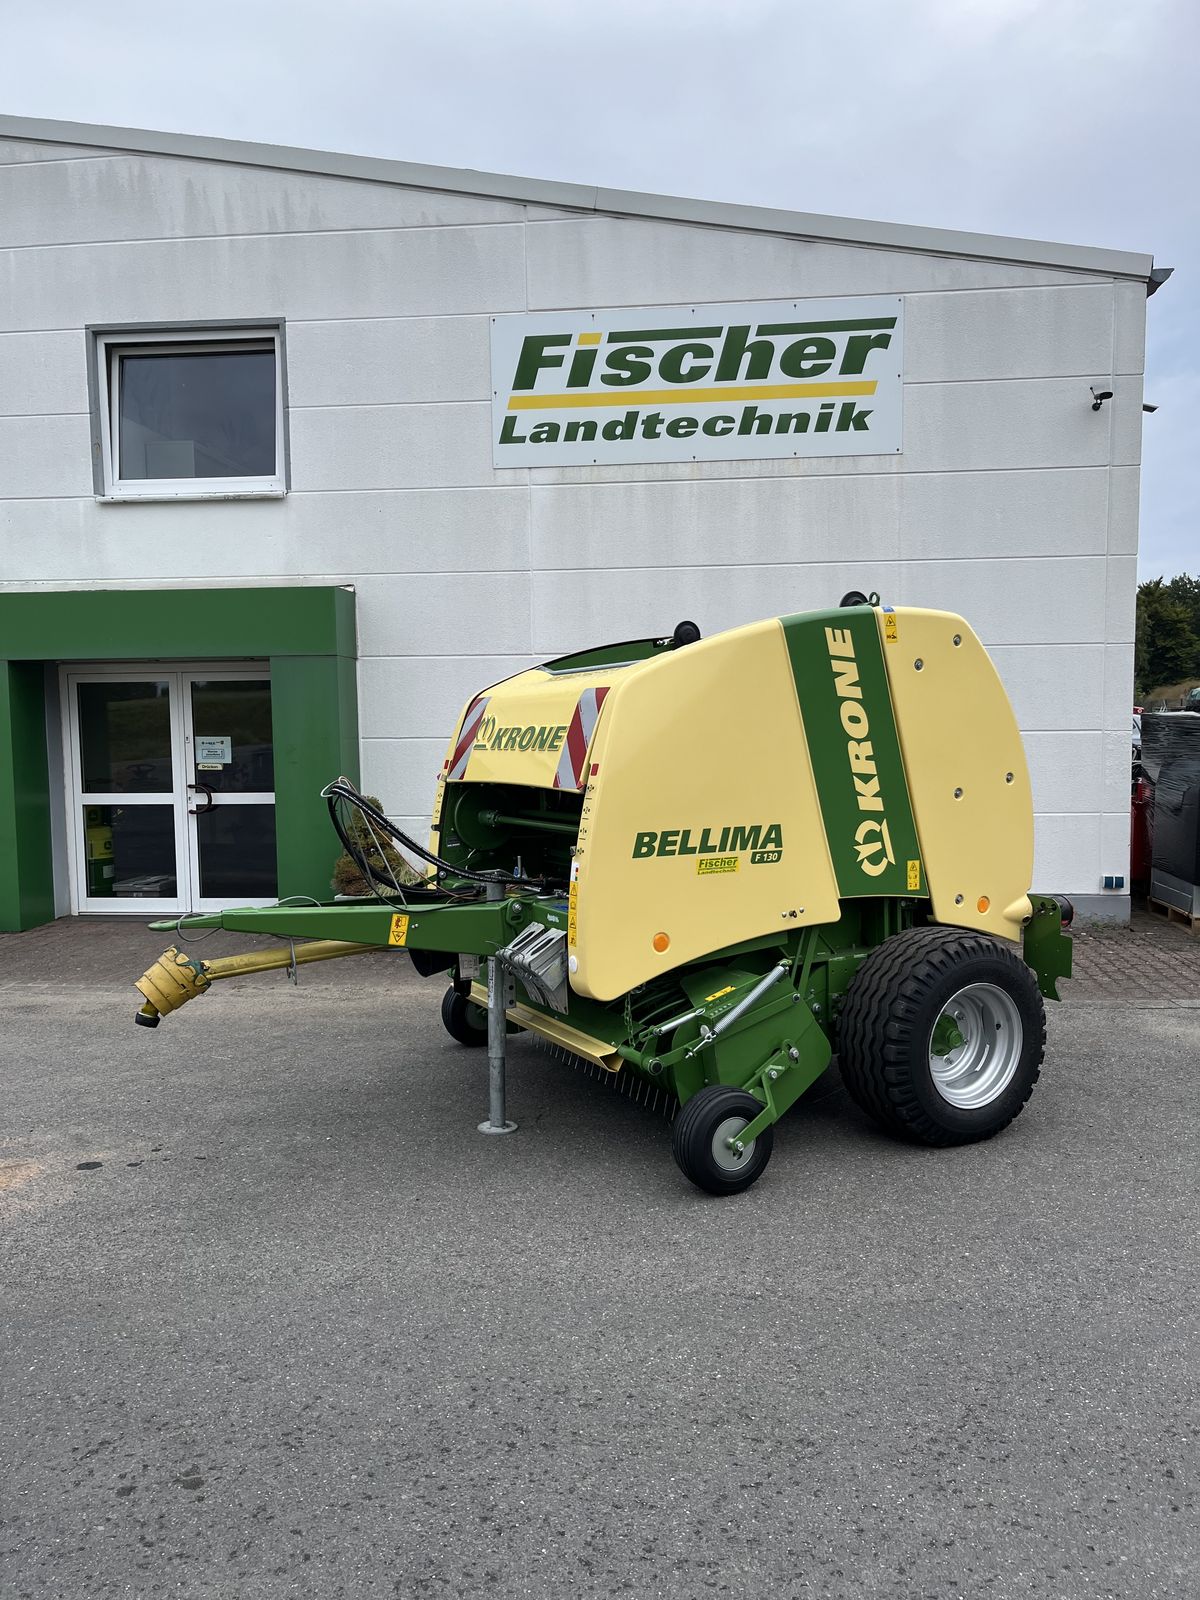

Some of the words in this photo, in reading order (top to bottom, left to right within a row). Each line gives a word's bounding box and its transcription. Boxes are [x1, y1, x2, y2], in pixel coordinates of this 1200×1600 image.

[512, 316, 898, 391] Fischer
[498, 401, 875, 445] Landtechnik
[824, 626, 885, 812] KRONE
[490, 725, 569, 752] KRONE
[632, 823, 783, 859] BELLIMA
[755, 853, 761, 862] F
[763, 852, 778, 862] 130
[699, 856, 738, 868] Fischer
